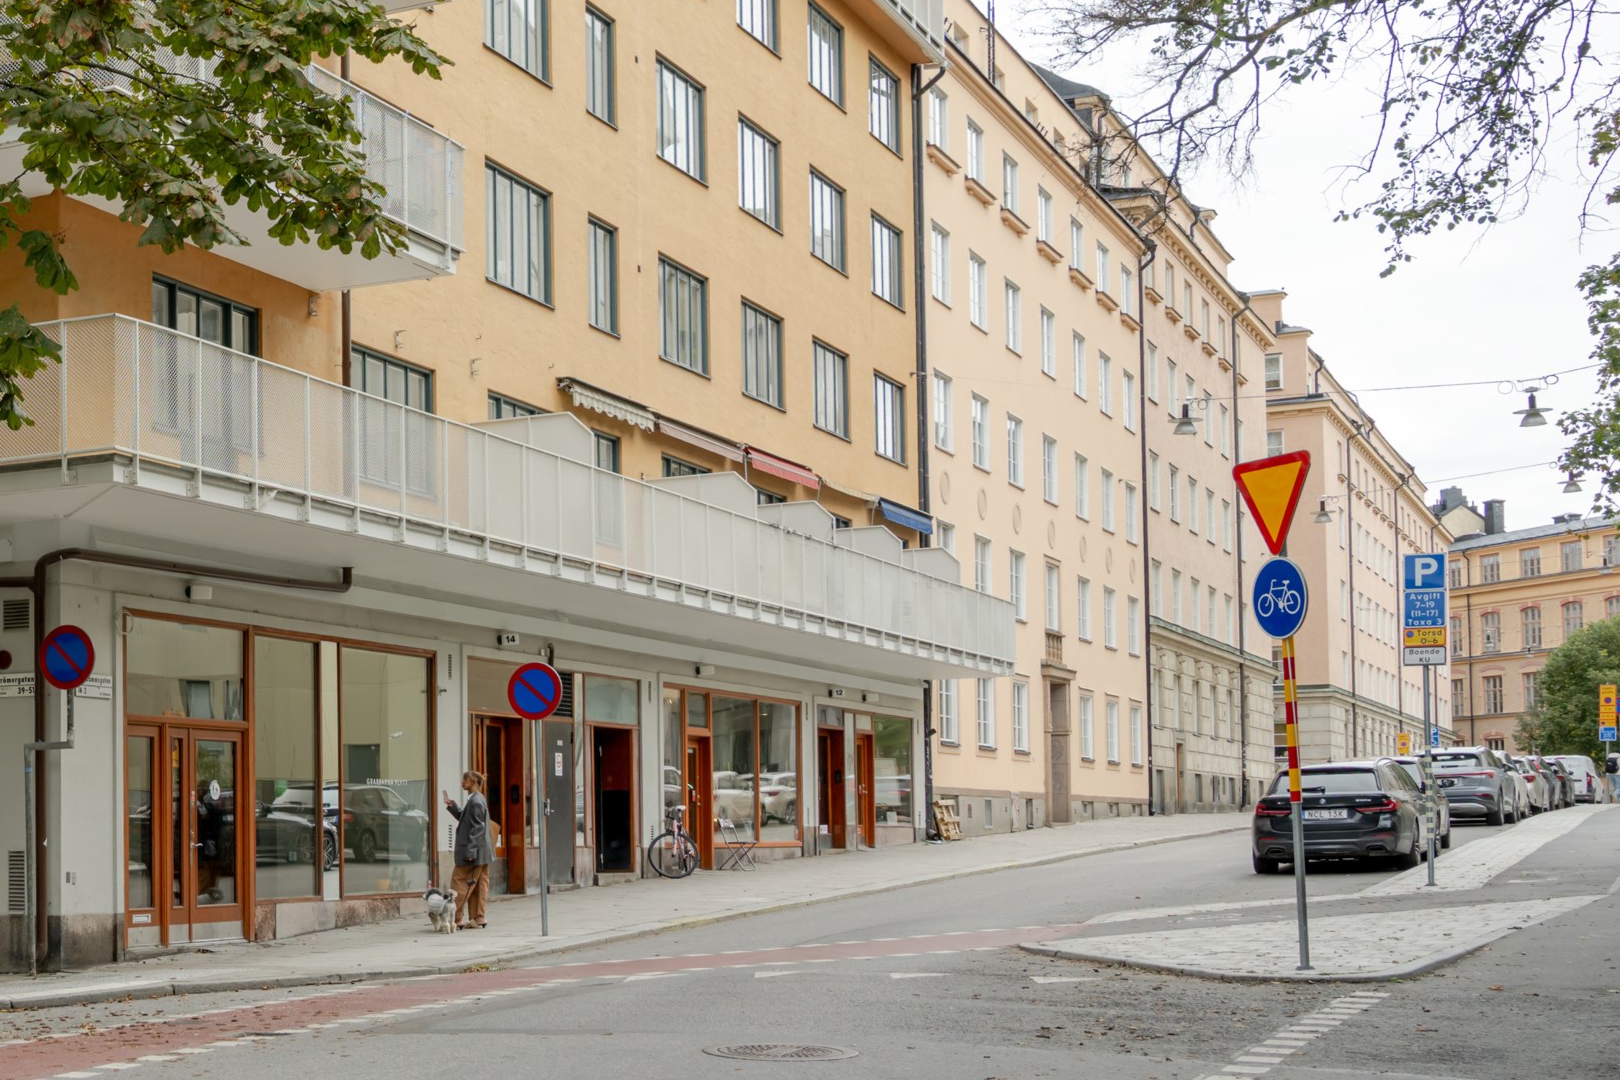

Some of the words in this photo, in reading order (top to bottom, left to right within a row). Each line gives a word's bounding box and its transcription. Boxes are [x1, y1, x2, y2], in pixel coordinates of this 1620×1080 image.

[1414, 557, 1439, 587] P
[1409, 593, 1440, 601] Avgift
[1414, 601, 1435, 609] 7-19
[1411, 609, 1439, 618] (11-17)
[1416, 629, 1443, 637] Torsd
[505, 635, 516, 643] 14
[17, 686, 35, 695] 39-51
[1328, 810, 1344, 818] 13K
